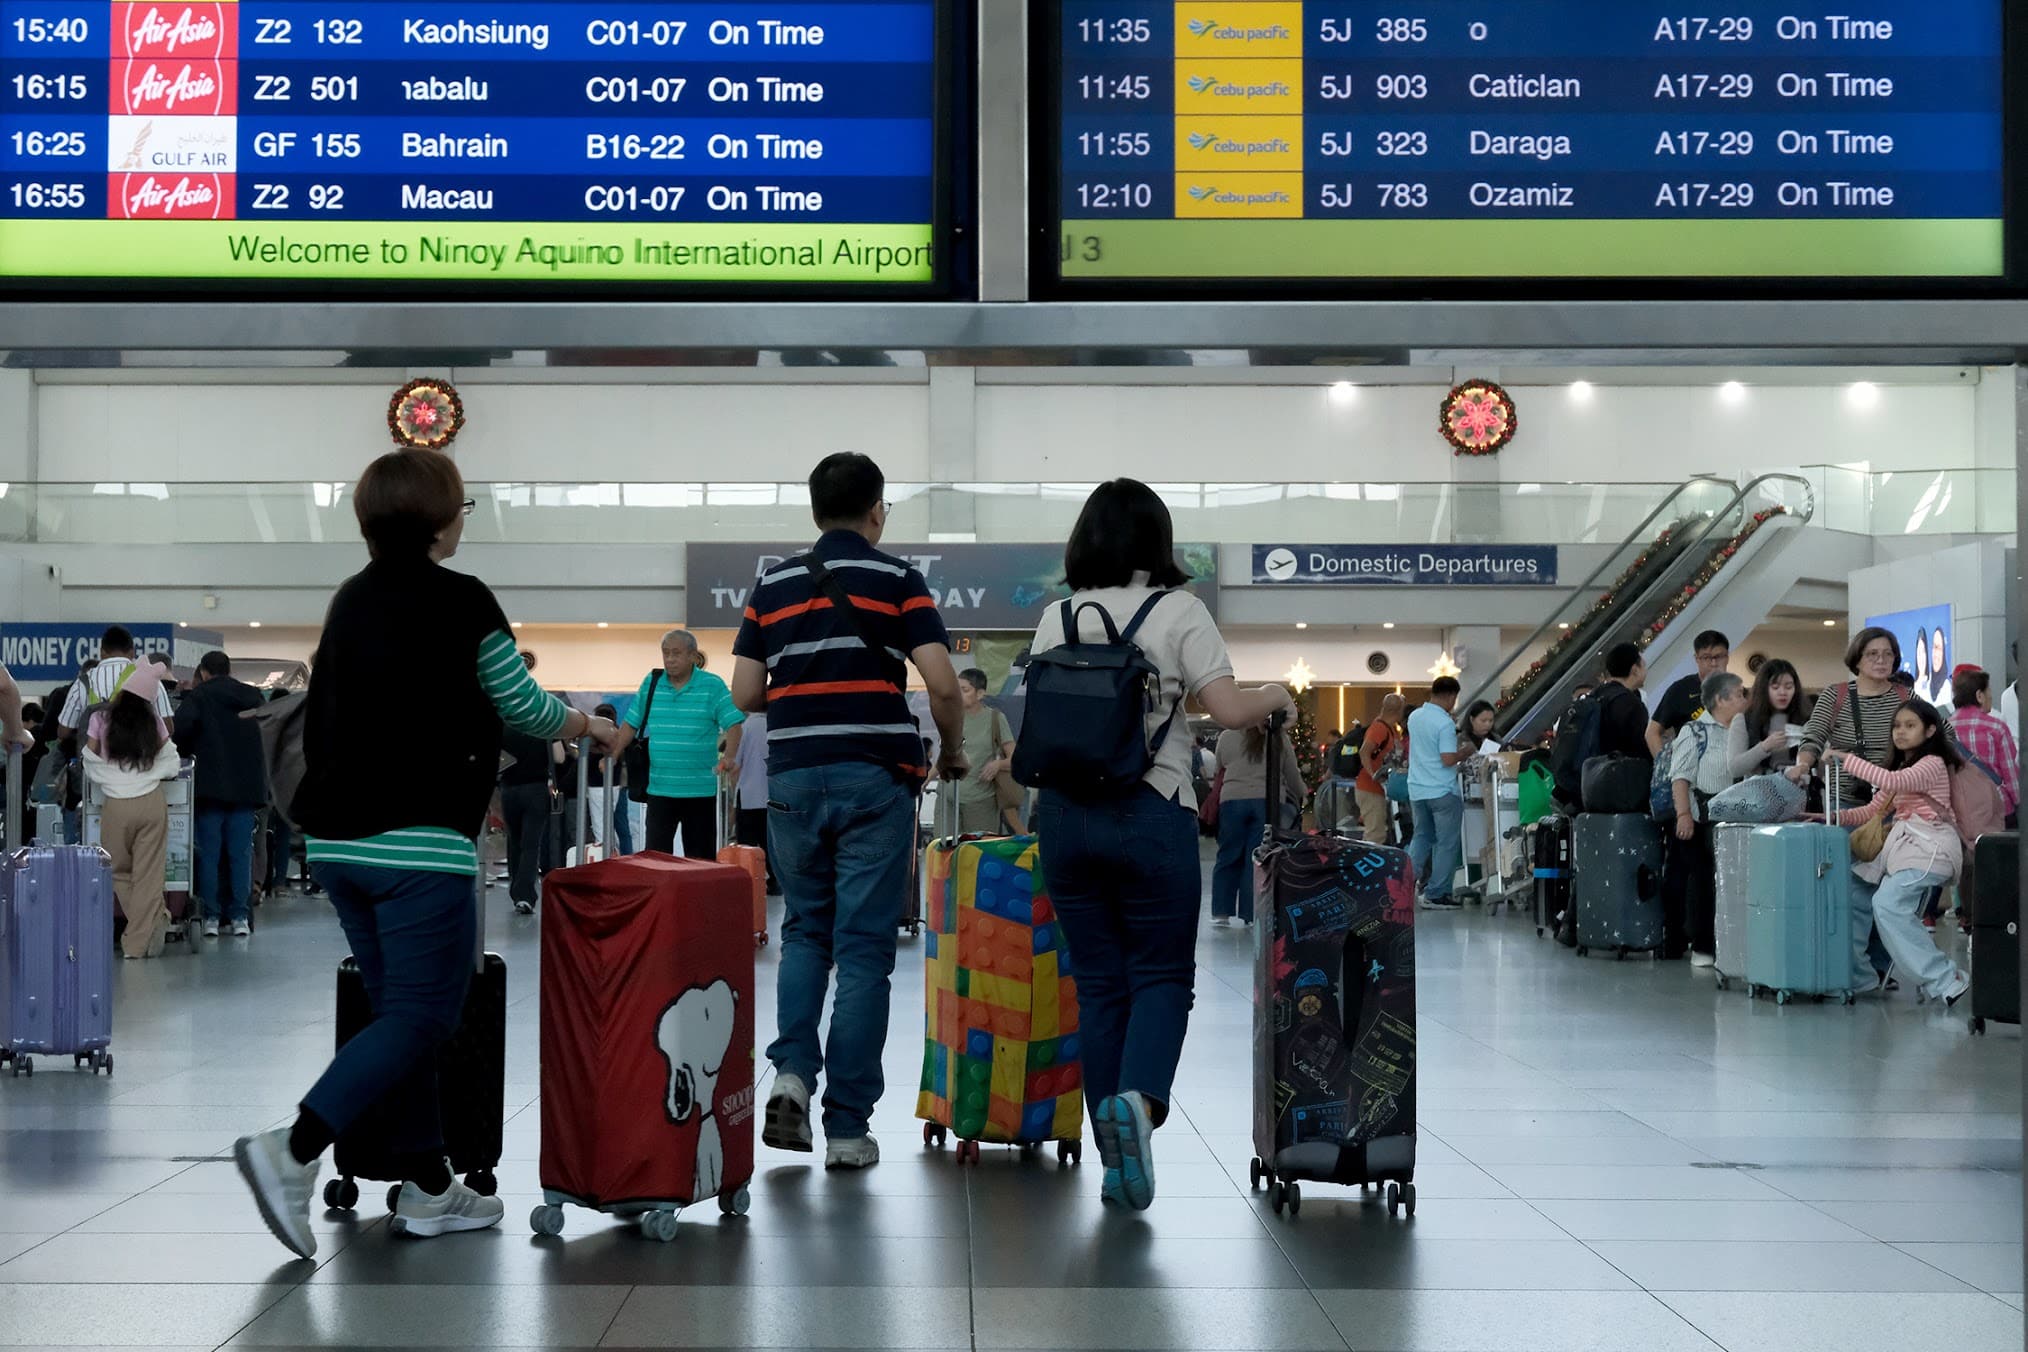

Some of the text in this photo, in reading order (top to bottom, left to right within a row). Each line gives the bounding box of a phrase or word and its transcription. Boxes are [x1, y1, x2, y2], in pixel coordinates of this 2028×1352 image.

[14, 18, 87, 42] 15:40
[255, 19, 362, 43] Z2 132
[404, 19, 548, 49] Kaohsiung
[587, 20, 686, 45] C01-07
[709, 20, 824, 44] On Time
[1079, 19, 1150, 42] 11:35
[1213, 25, 1290, 42] cebu pacific
[1320, 18, 1427, 42] 5J 385
[1655, 17, 1752, 40] A17-29
[1777, 16, 1892, 39] On Time
[13, 75, 86, 99] 16:15
[254, 76, 357, 100] Z2 501
[586, 77, 686, 102] C01-07
[708, 77, 823, 102] On Time
[1079, 75, 1150, 98] 11:45
[1213, 82, 1290, 99] cebu pacific
[1321, 75, 1427, 98] 5J 903
[1469, 74, 1580, 97] Caticlan
[1655, 74, 1753, 97] A17-29
[1777, 73, 1892, 96] On Time
[12, 132, 85, 156] 16:25
[254, 132, 360, 157] GF 155
[403, 133, 507, 157] Bahrain
[587, 134, 684, 159] B16-22
[708, 134, 822, 159] On Time
[1079, 132, 1150, 155] 11:55
[1213, 139, 1290, 156] cebu pacific
[1321, 132, 1427, 155] 5J 323
[1471, 131, 1571, 160] Daraga
[1655, 131, 1753, 155] A17-29
[1778, 130, 1893, 153] On Time
[152, 153, 226, 165] GULF AIR
[11, 183, 85, 207] 16:55
[252, 184, 343, 209] Z2 92
[402, 185, 492, 209] Macau
[585, 186, 685, 211] C01-07
[707, 186, 822, 210] On Time
[1078, 184, 1151, 207] 12:10
[1213, 190, 1290, 207] cebu pacific
[1321, 184, 1427, 207] 5J 783
[1470, 183, 1573, 206] Ozamiz
[1656, 183, 1753, 206] A17-29
[1778, 182, 1893, 205] On Time
[229, 236, 933, 273] Welcome to Ninoy Aquino International Airport
[1082, 236, 1100, 261] 3
[1310, 554, 1537, 578] Domestic Departures
[2, 637, 71, 665] MONEY
[76, 637, 170, 665] CHGER
[1353, 851, 1386, 878] EU
